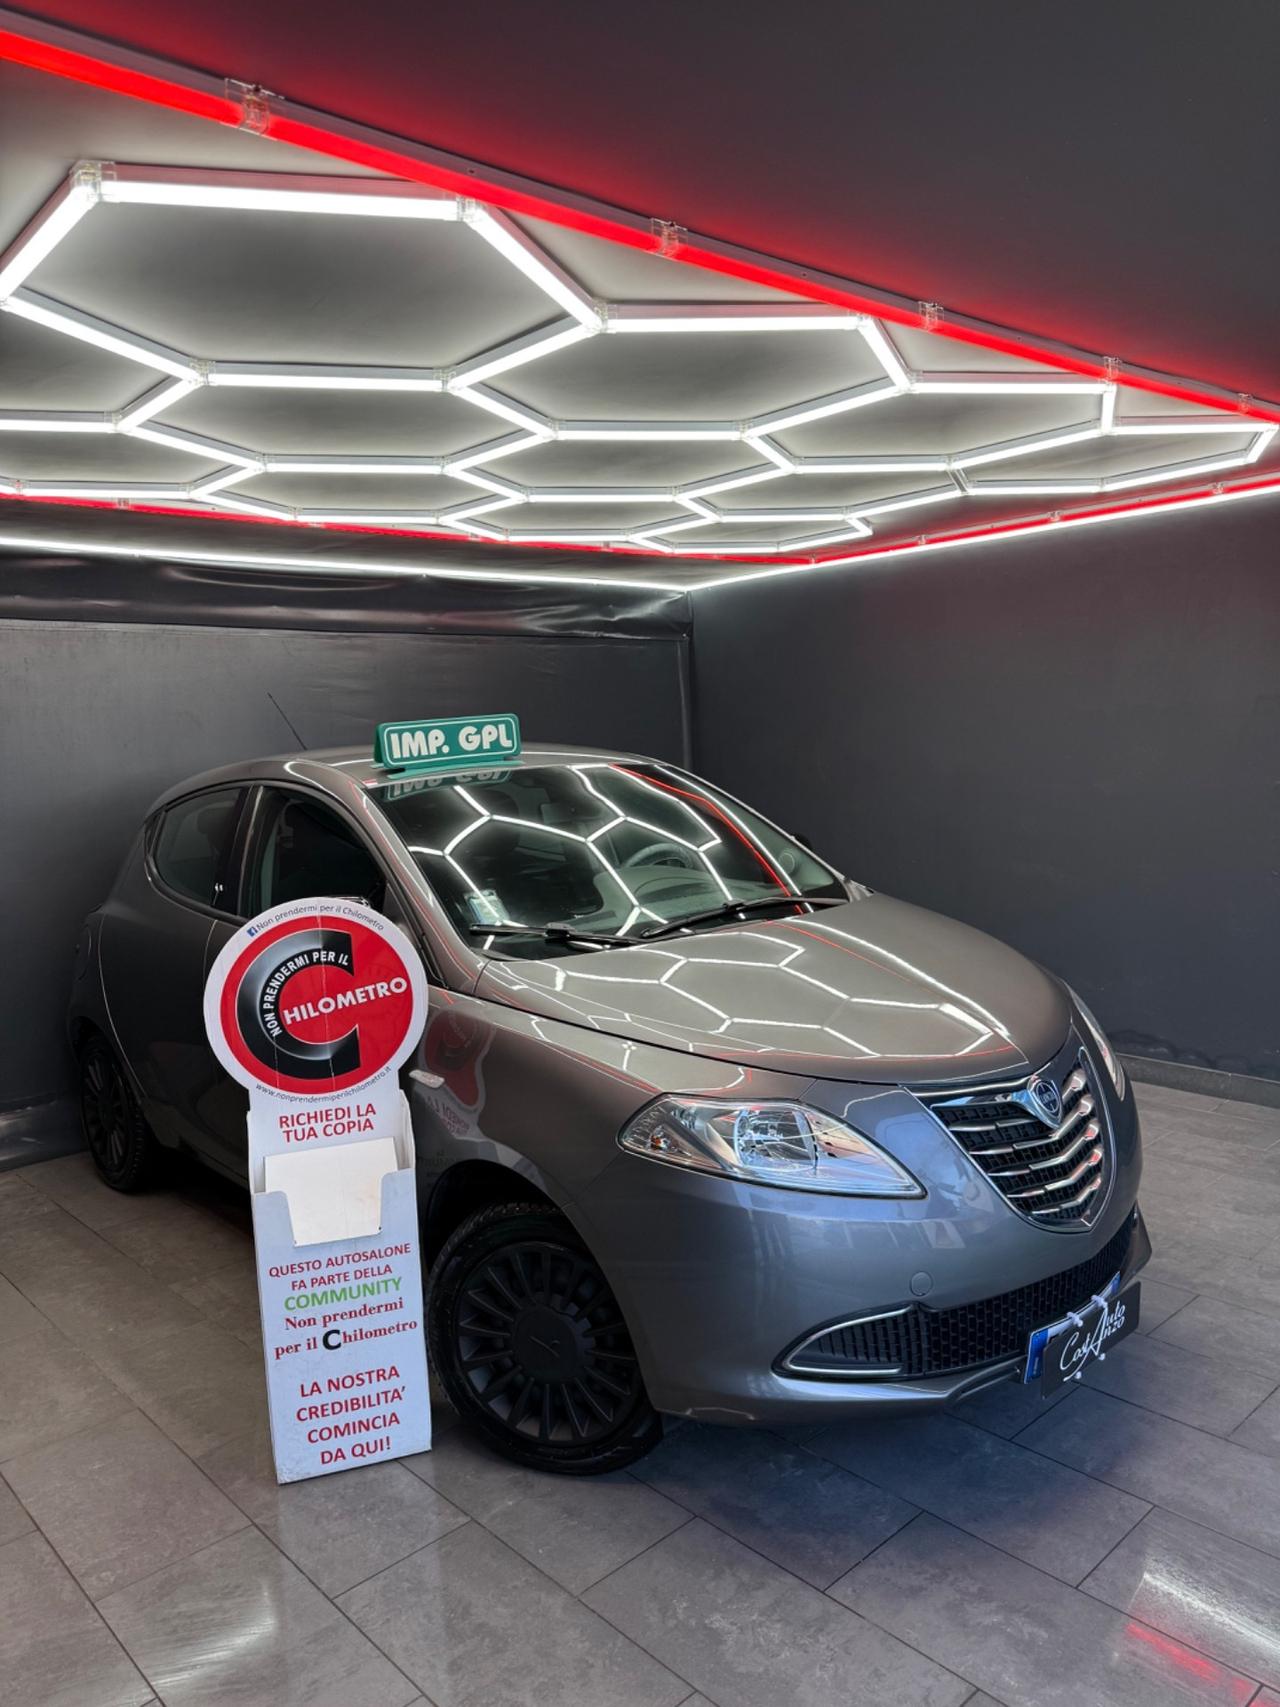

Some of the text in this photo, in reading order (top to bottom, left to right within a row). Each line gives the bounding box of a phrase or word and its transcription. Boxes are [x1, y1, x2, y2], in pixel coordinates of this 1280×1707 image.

[390, 724, 513, 759] IMP. GPL
[256, 904, 384, 931] Non prendermi per il Chilometro
[263, 951, 349, 1037] NON PRENDERMI PER IL
[279, 1103, 376, 1129] RICHIEDI LA
[282, 1119, 374, 1143] TUA COPIA
[269, 1243, 411, 1278] QUESTO AUTOSALONE
[284, 1277, 402, 1311] COMMUNITY
[291, 1264, 393, 1291] FA PARTE DELLA
[285, 1297, 404, 1331] Non prendermi
[274, 1320, 418, 1360] per il Chilometro
[300, 1366, 400, 1398] LA NOSTRA
[296, 1386, 406, 1422] CREDIBILITA'
[307, 1412, 400, 1444] COMINCIA
[321, 1436, 391, 1465] DA QUI!
